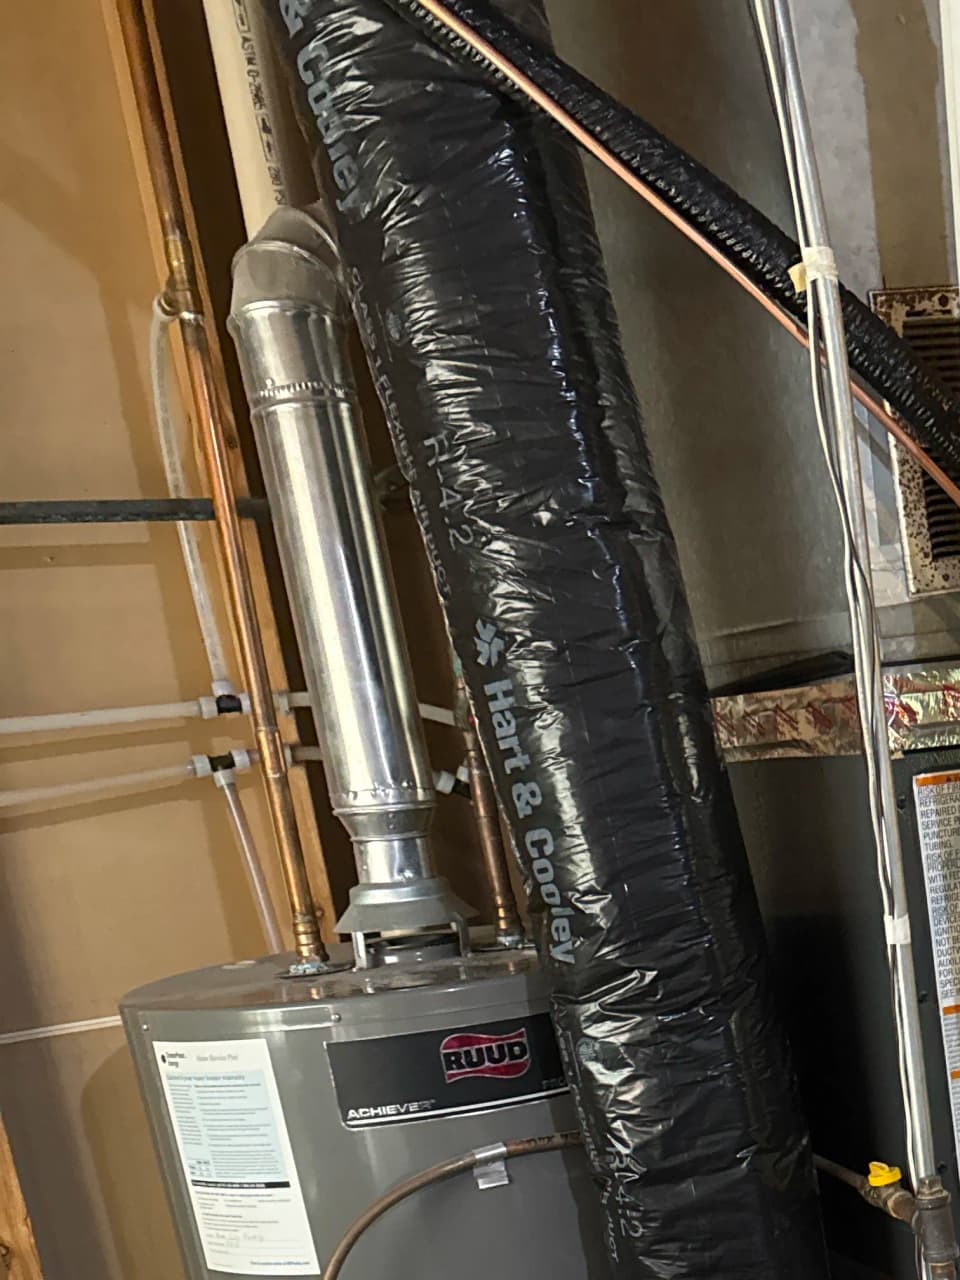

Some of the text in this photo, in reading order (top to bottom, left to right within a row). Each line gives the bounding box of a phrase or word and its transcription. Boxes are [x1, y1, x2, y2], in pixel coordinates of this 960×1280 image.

[241, 36, 257, 66] ASTM
[297, 43, 359, 213] Cooley
[920, 807, 956, 819] REPAIRED
[484, 678, 576, 965] Hart & Cooley
[921, 817, 952, 830] SERVICE
[928, 873, 946, 884] WITH
[936, 937, 950, 947] NOT
[952, 935, 960, 945] BE
[939, 967, 953, 978] FOR
[443, 1041, 528, 1072] RUUD
[347, 1101, 431, 1120] ACHIEVER
